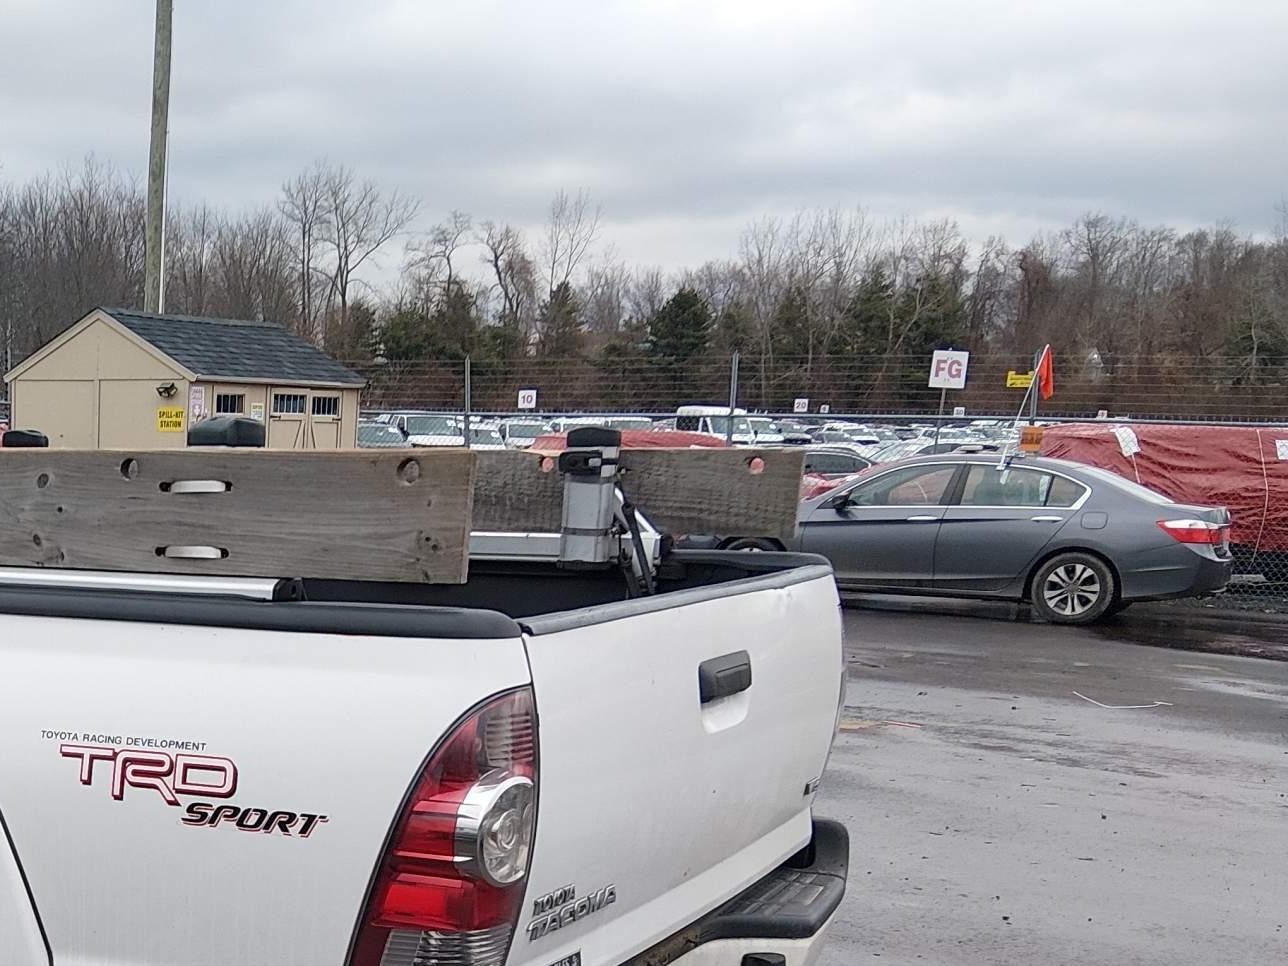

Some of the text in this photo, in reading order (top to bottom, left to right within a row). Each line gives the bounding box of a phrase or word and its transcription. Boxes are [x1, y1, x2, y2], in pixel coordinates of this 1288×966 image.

[934, 359, 963, 379] FG
[521, 395, 533, 404] 10
[159, 420, 182, 428] STATION
[41, 730, 207, 751] TOYOTA RACING DEVELOPMENT
[60, 743, 239, 806] TRD
[181, 802, 330, 838] SPORT
[527, 884, 616, 941] TACOMA
